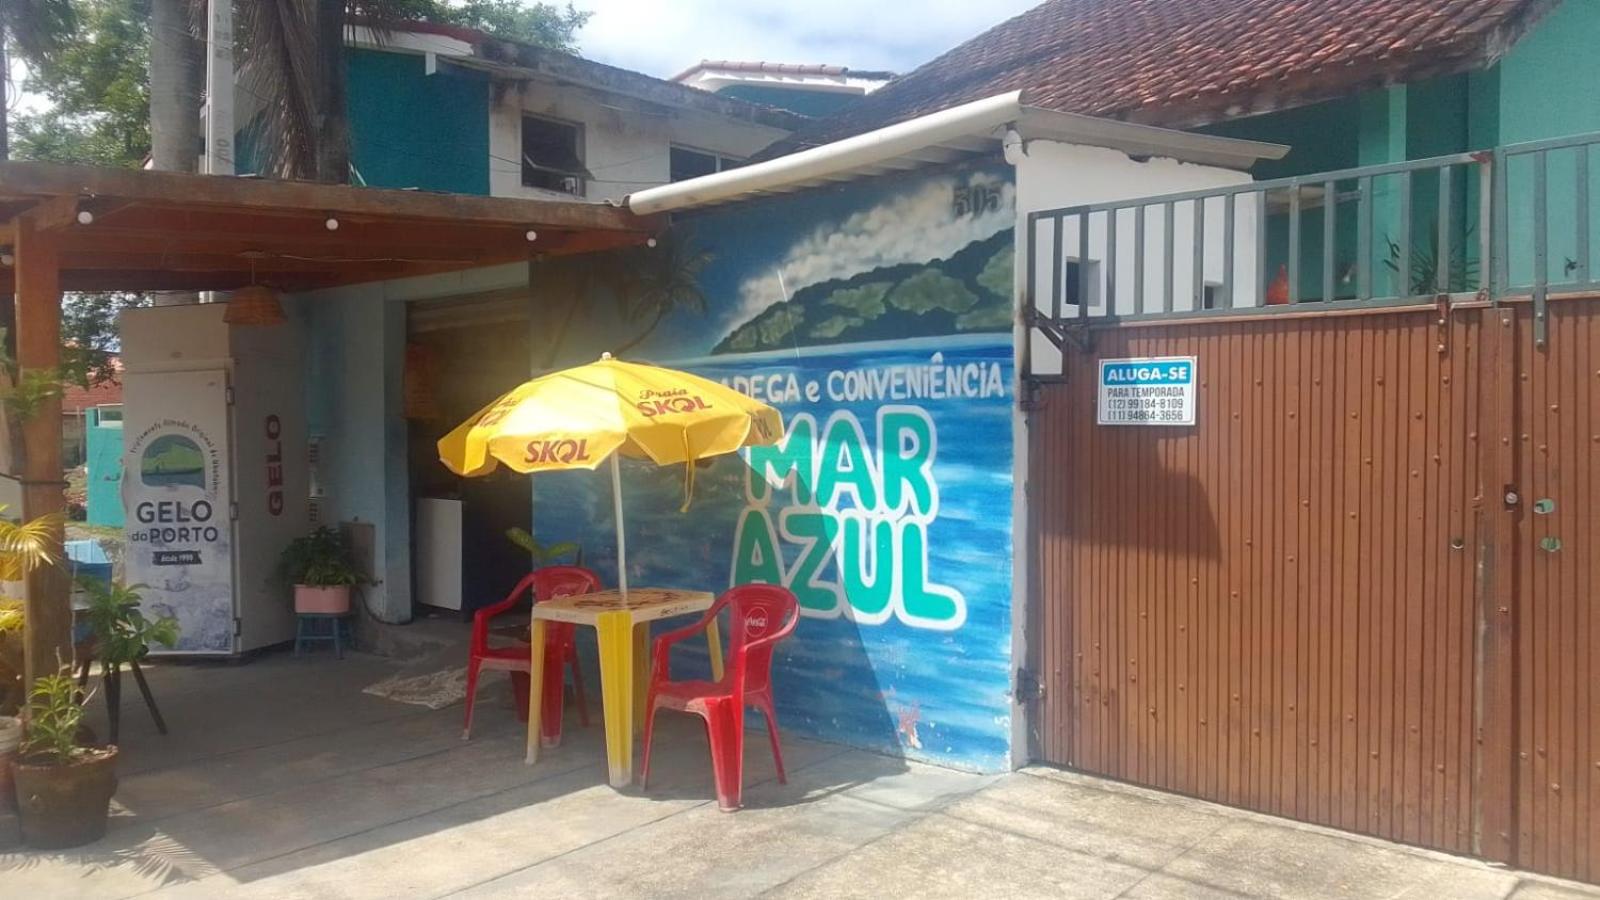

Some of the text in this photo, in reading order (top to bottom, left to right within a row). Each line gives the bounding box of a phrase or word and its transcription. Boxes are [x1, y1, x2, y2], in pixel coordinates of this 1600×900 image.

[1107, 366, 1187, 381] ALUGA-SE
[639, 388, 688, 400] Praia
[721, 373, 801, 404] DEGA
[805, 380, 821, 402] e
[1107, 386, 1184, 398] PARA TEMPORADA
[637, 396, 713, 417] SKOL
[524, 438, 590, 464] SKOL
[266, 414, 283, 516] GELO
[745, 405, 939, 525] MAR
[136, 500, 212, 523] GELO
[149, 526, 218, 543] PORTO
[730, 507, 967, 631] AZUL
